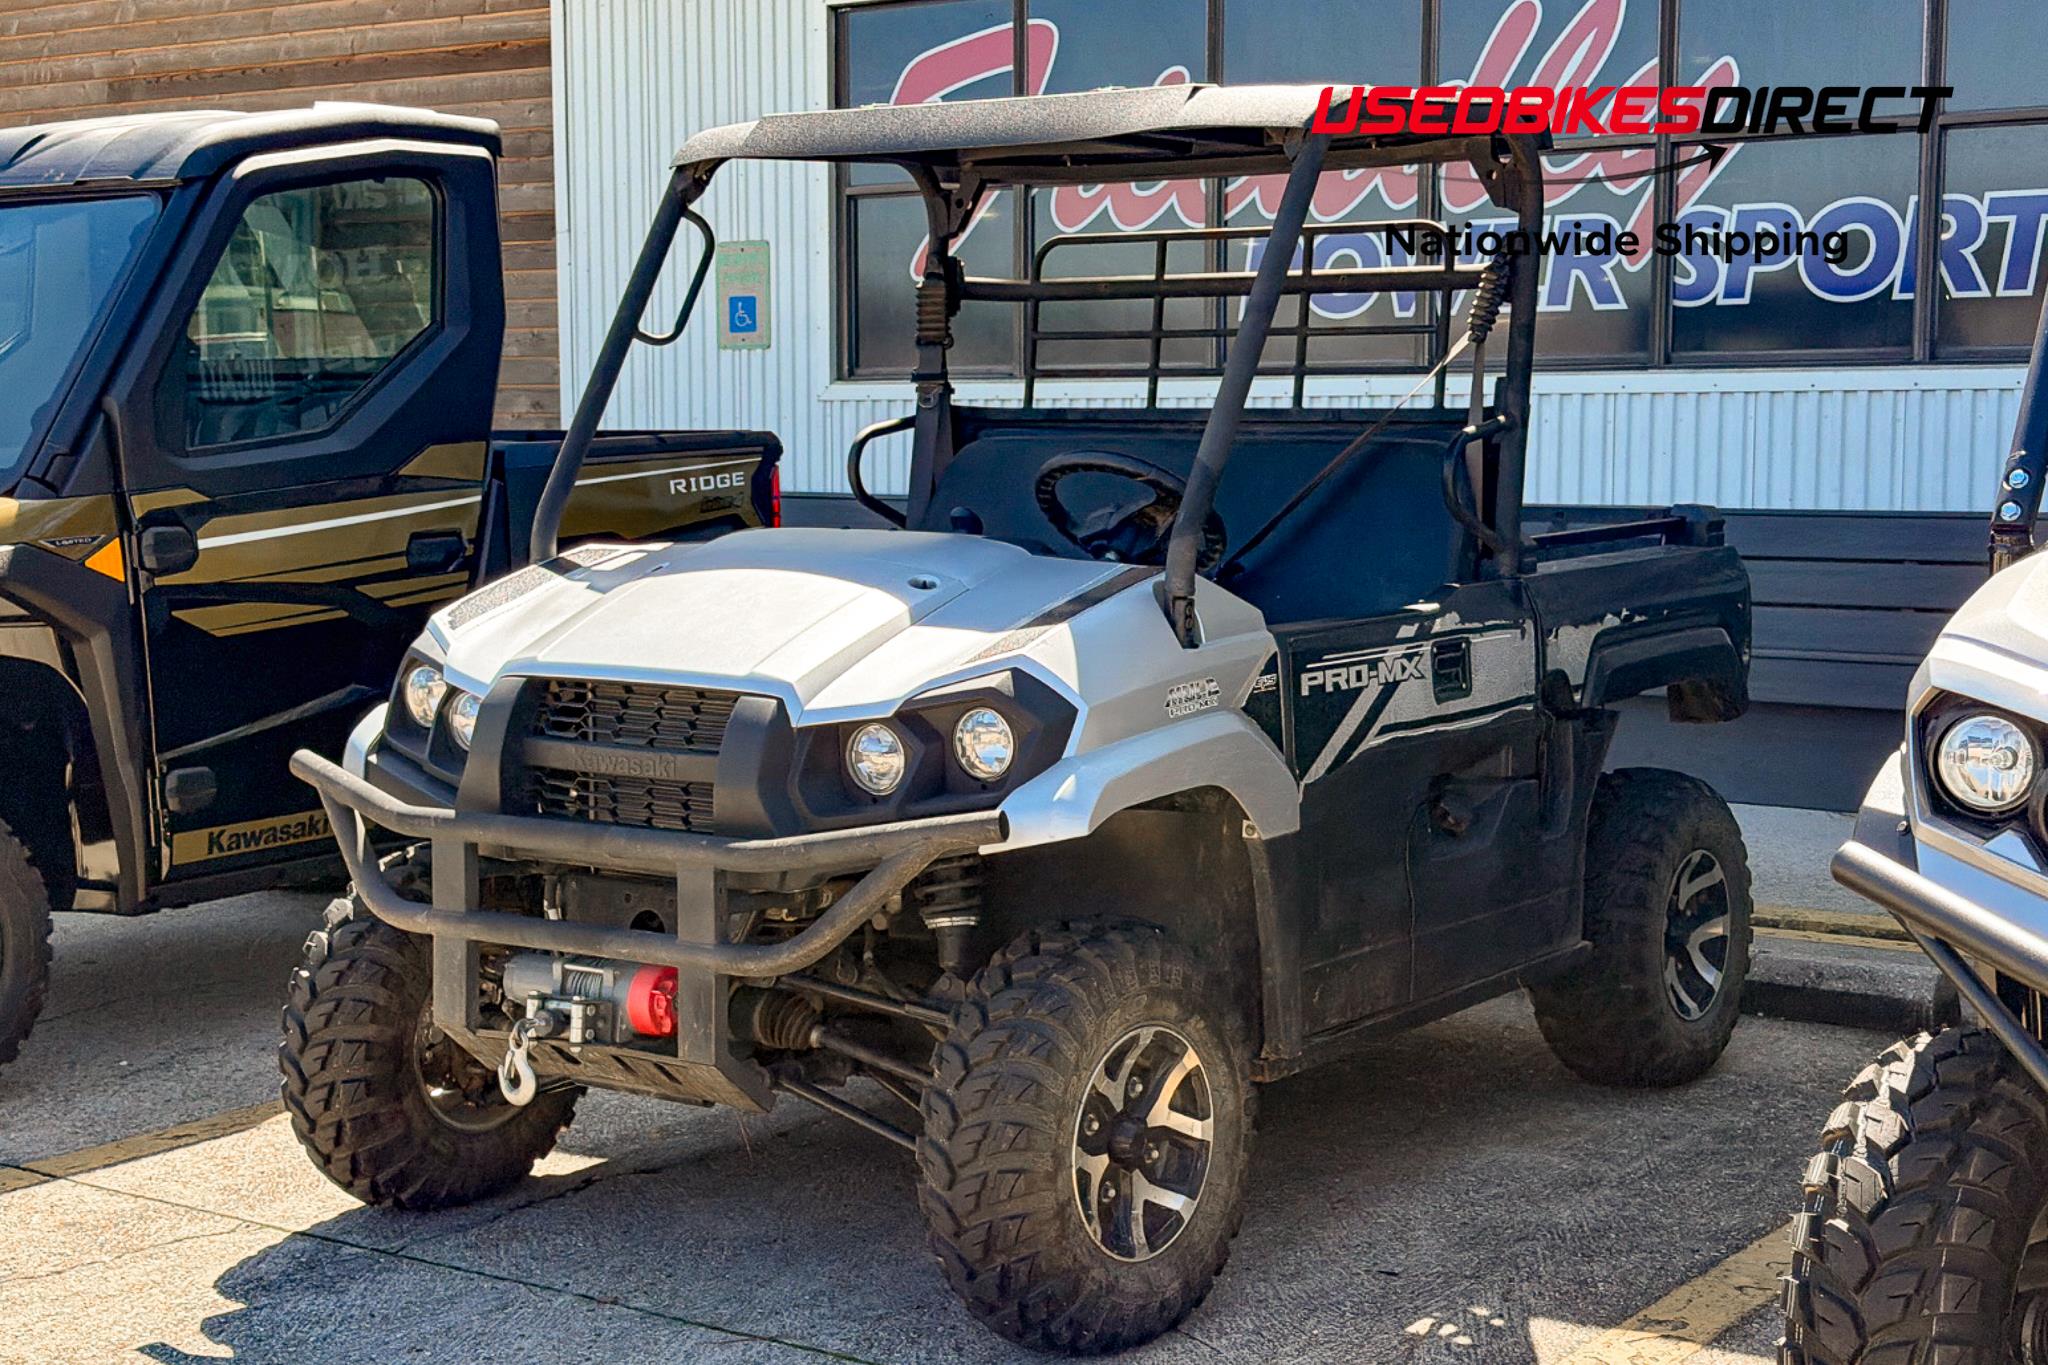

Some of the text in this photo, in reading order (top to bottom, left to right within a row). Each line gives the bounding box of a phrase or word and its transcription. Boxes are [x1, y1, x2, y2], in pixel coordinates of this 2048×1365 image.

[669, 471, 745, 495] RIDGE
[1300, 654, 1425, 697] PRO-MX
[570, 746, 678, 778] Kawasaki
[206, 814, 330, 855] Kawasaki
